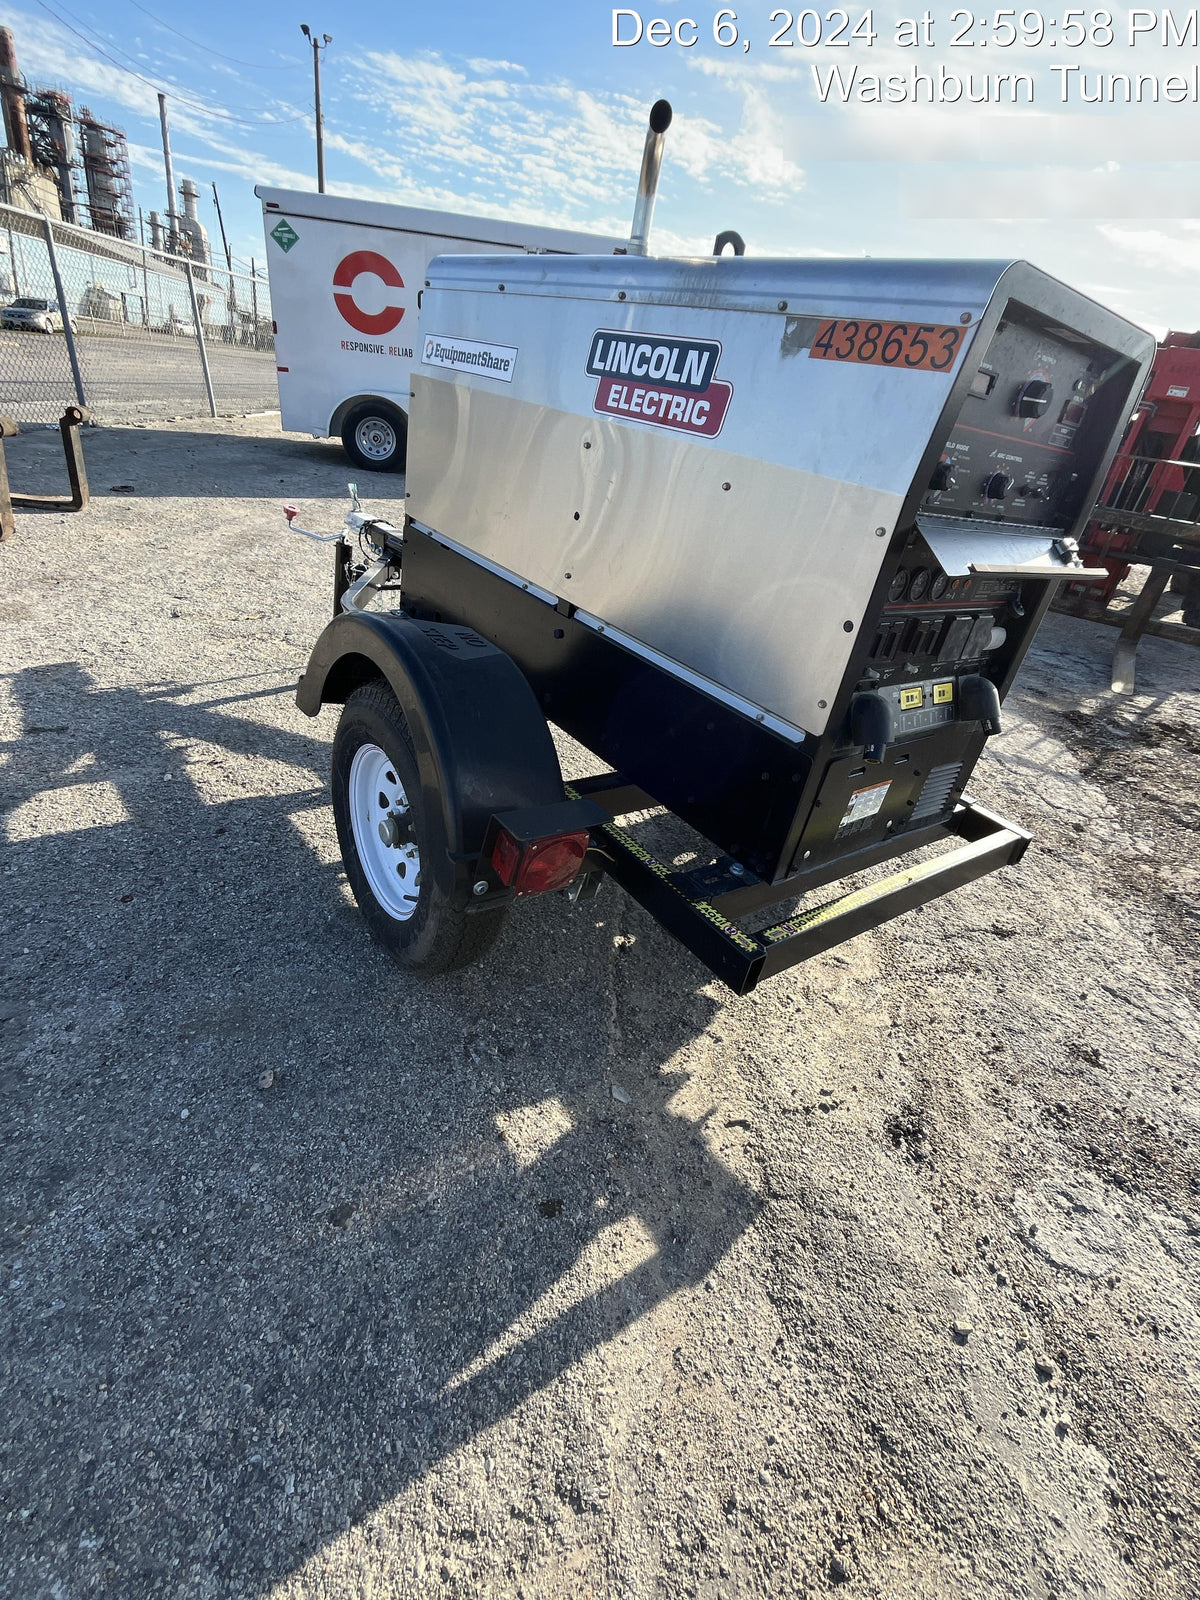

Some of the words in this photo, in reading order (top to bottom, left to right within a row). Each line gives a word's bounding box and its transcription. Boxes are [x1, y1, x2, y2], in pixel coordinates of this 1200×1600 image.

[340, 340, 387, 355] RESPONSIVE.
[388, 346, 413, 358] RELIAB
[434, 343, 510, 372] EquipmentShare
[815, 320, 960, 369] 438653
[592, 339, 710, 386] LINCOLN
[606, 384, 711, 426] ELECTRIC
[792, 917, 808, 929] DO
